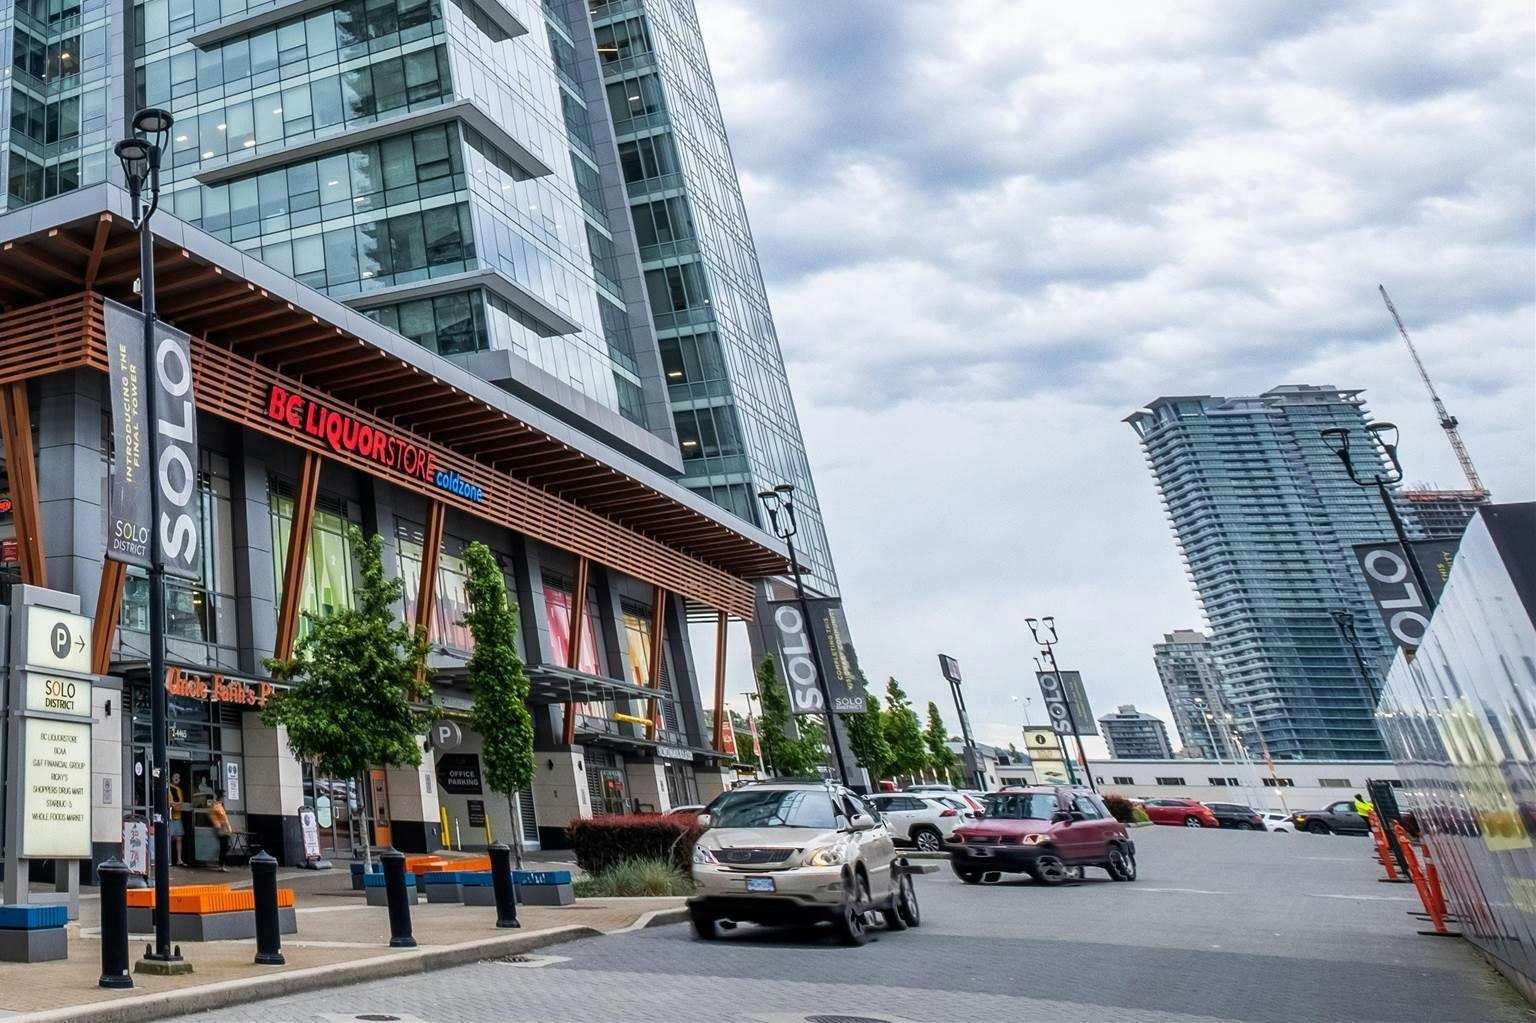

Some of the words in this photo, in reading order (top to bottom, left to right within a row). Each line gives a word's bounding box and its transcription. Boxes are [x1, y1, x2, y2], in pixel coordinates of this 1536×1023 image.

[119, 343, 128, 374] THE
[130, 364, 140, 418] TOWER
[268, 385, 303, 428] BC
[120, 378, 133, 482] INTRODUCING
[132, 423, 141, 468] FINAL
[156, 338, 197, 564] SOLO
[435, 469, 484, 503] coldzone
[115, 519, 148, 544] SOLO
[114, 538, 146, 556] DISTRICT
[1364, 549, 1431, 646] OLO
[774, 605, 824, 709] SOLO
[45, 679, 76, 699] SOLO
[835, 696, 863, 706] SOLO
[45, 697, 75, 711] DISTRICT
[1039, 675, 1072, 733] SOLO
[44, 759, 68, 769] FINANCIAL
[69, 760, 86, 769] GROUP
[449, 770, 475, 778] OFFICE
[32, 785, 58, 795] SHOPPERS
[58, 786, 72, 795] DRUG
[72, 787, 84, 795] MART
[447, 778, 480, 786] PARKING
[45, 799, 73, 808] STARBUCS
[31, 812, 49, 821] WHOLE
[49, 812, 66, 821] FOODS
[66, 814, 84, 822] MARKET
